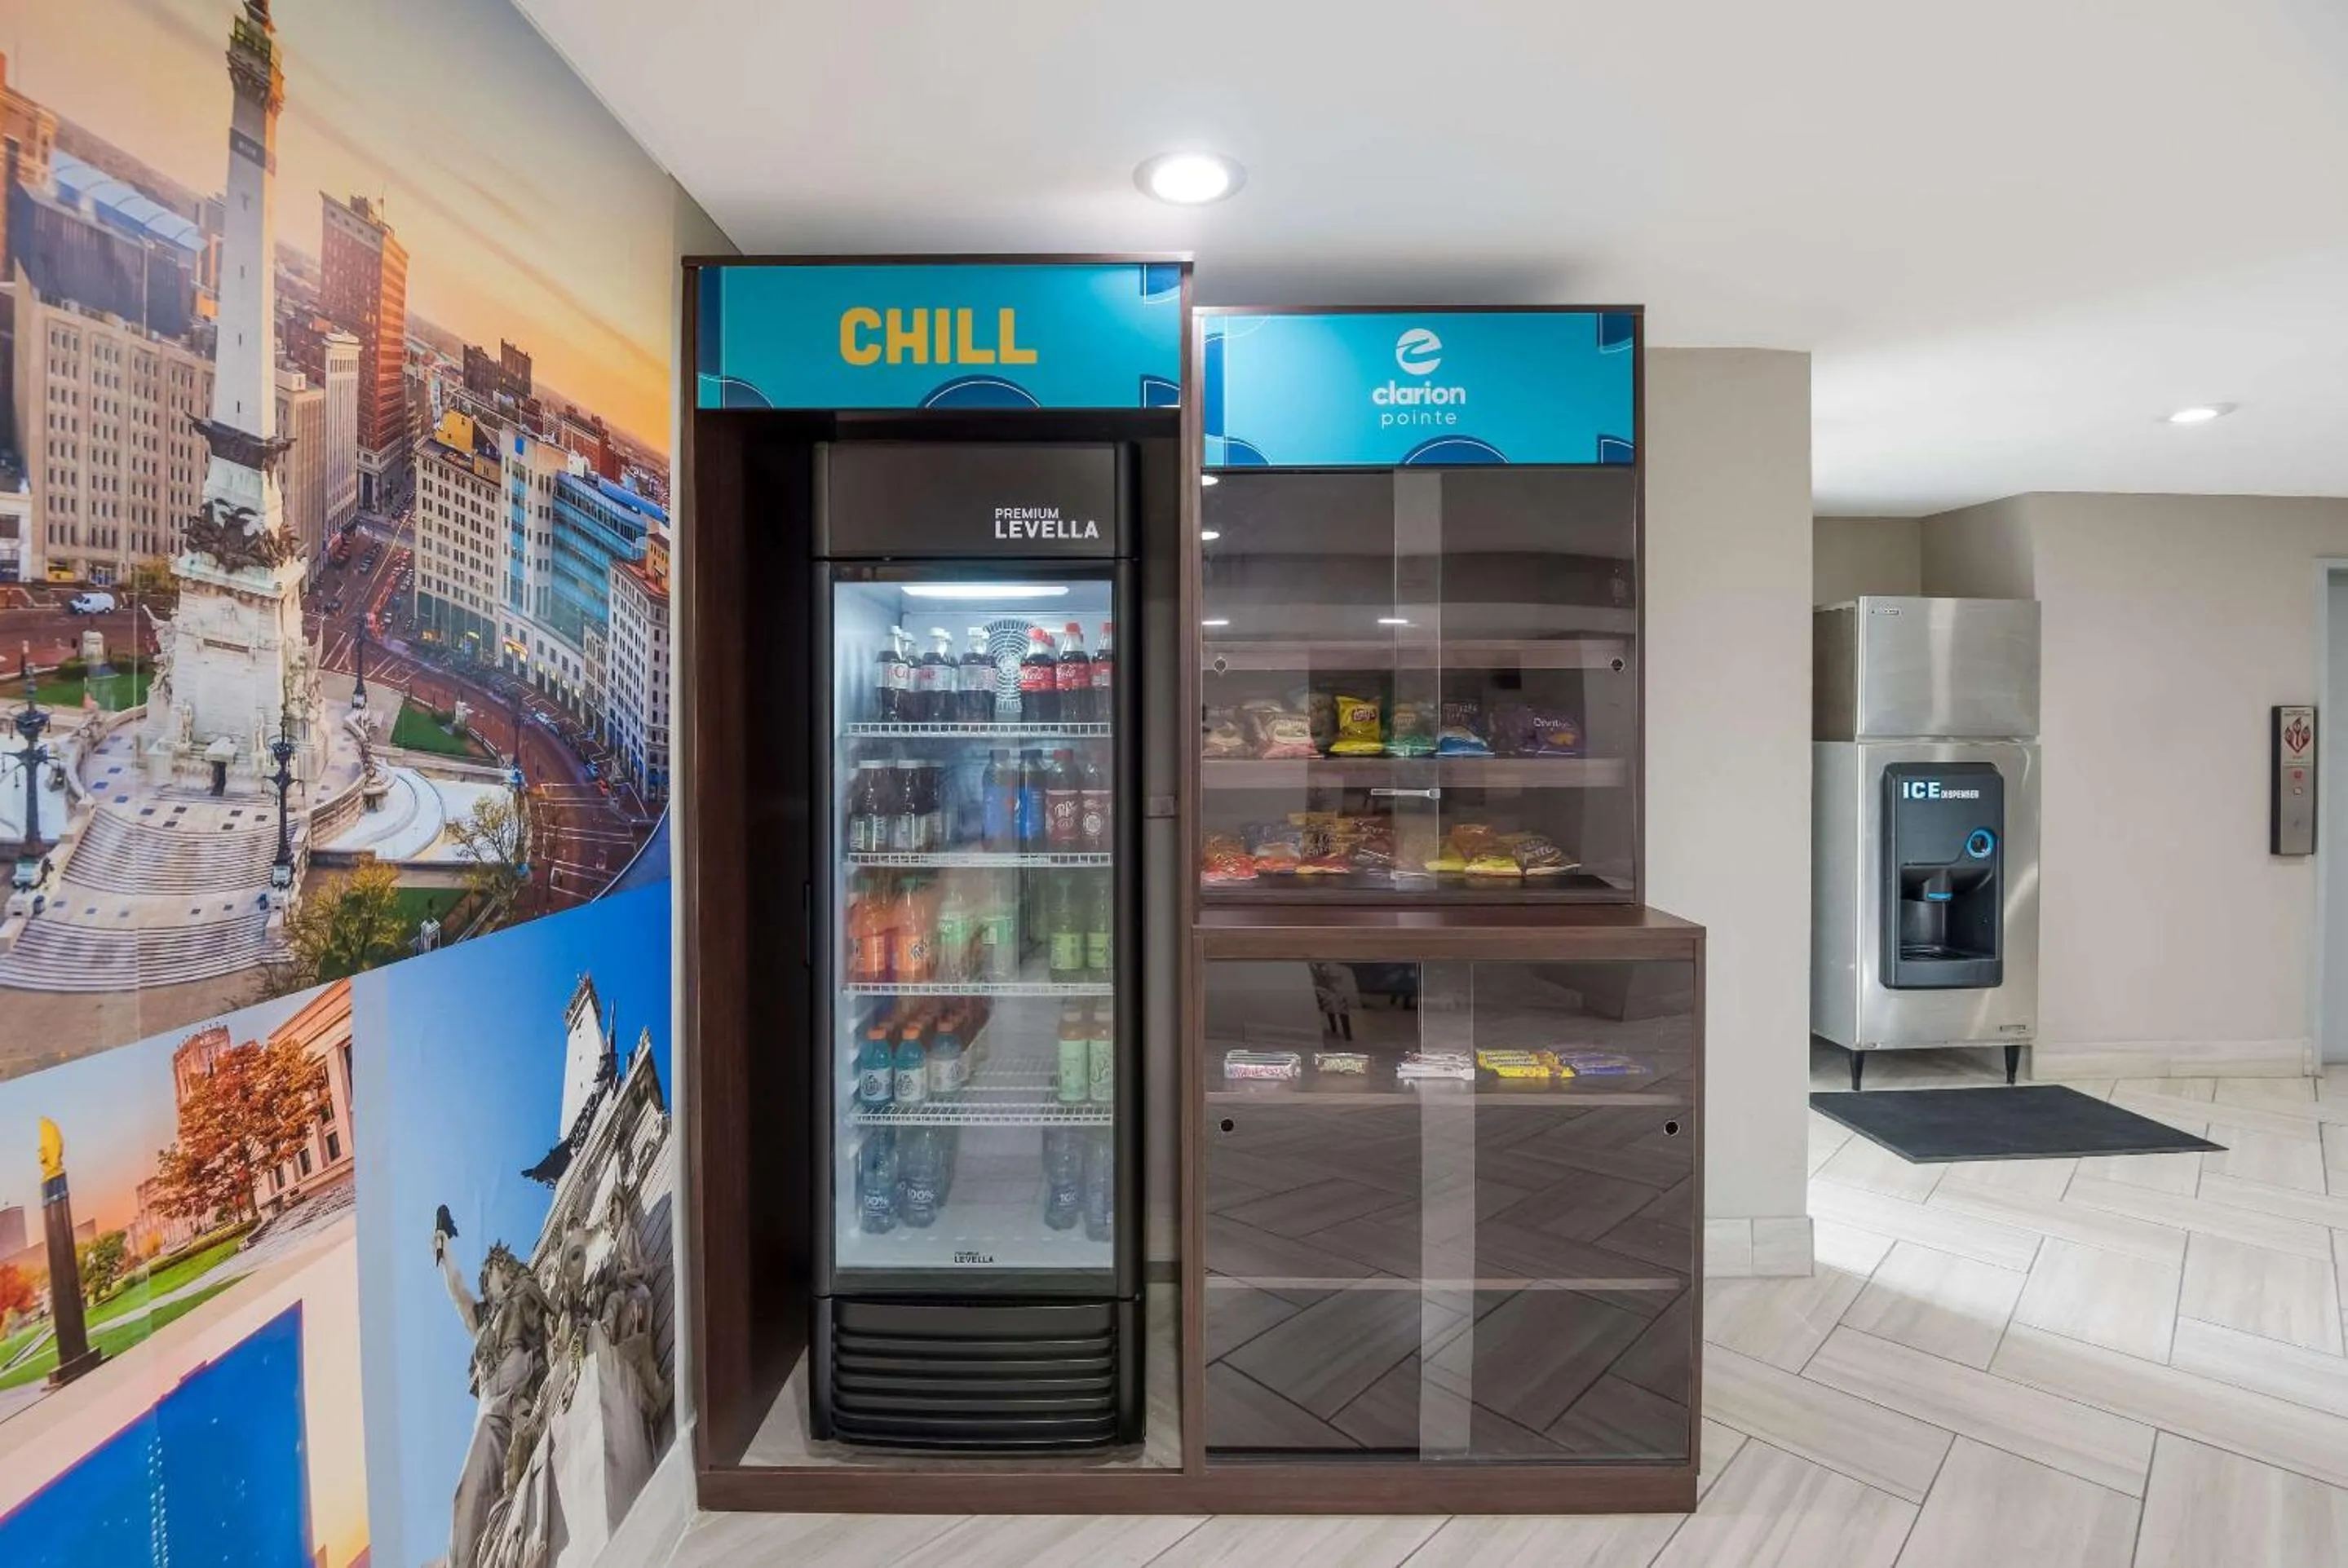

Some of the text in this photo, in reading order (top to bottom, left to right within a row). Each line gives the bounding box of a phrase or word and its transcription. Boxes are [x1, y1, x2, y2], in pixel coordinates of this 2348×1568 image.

[840, 307, 1037, 365] CHILL
[1372, 379, 1466, 405] clarion
[1382, 409, 1457, 429] pointe
[995, 507, 1059, 519] PREMIUM
[995, 520, 1099, 539] LEVELLA
[1903, 781, 1940, 799] ICE
[954, 1256, 994, 1264] LEVELLA
